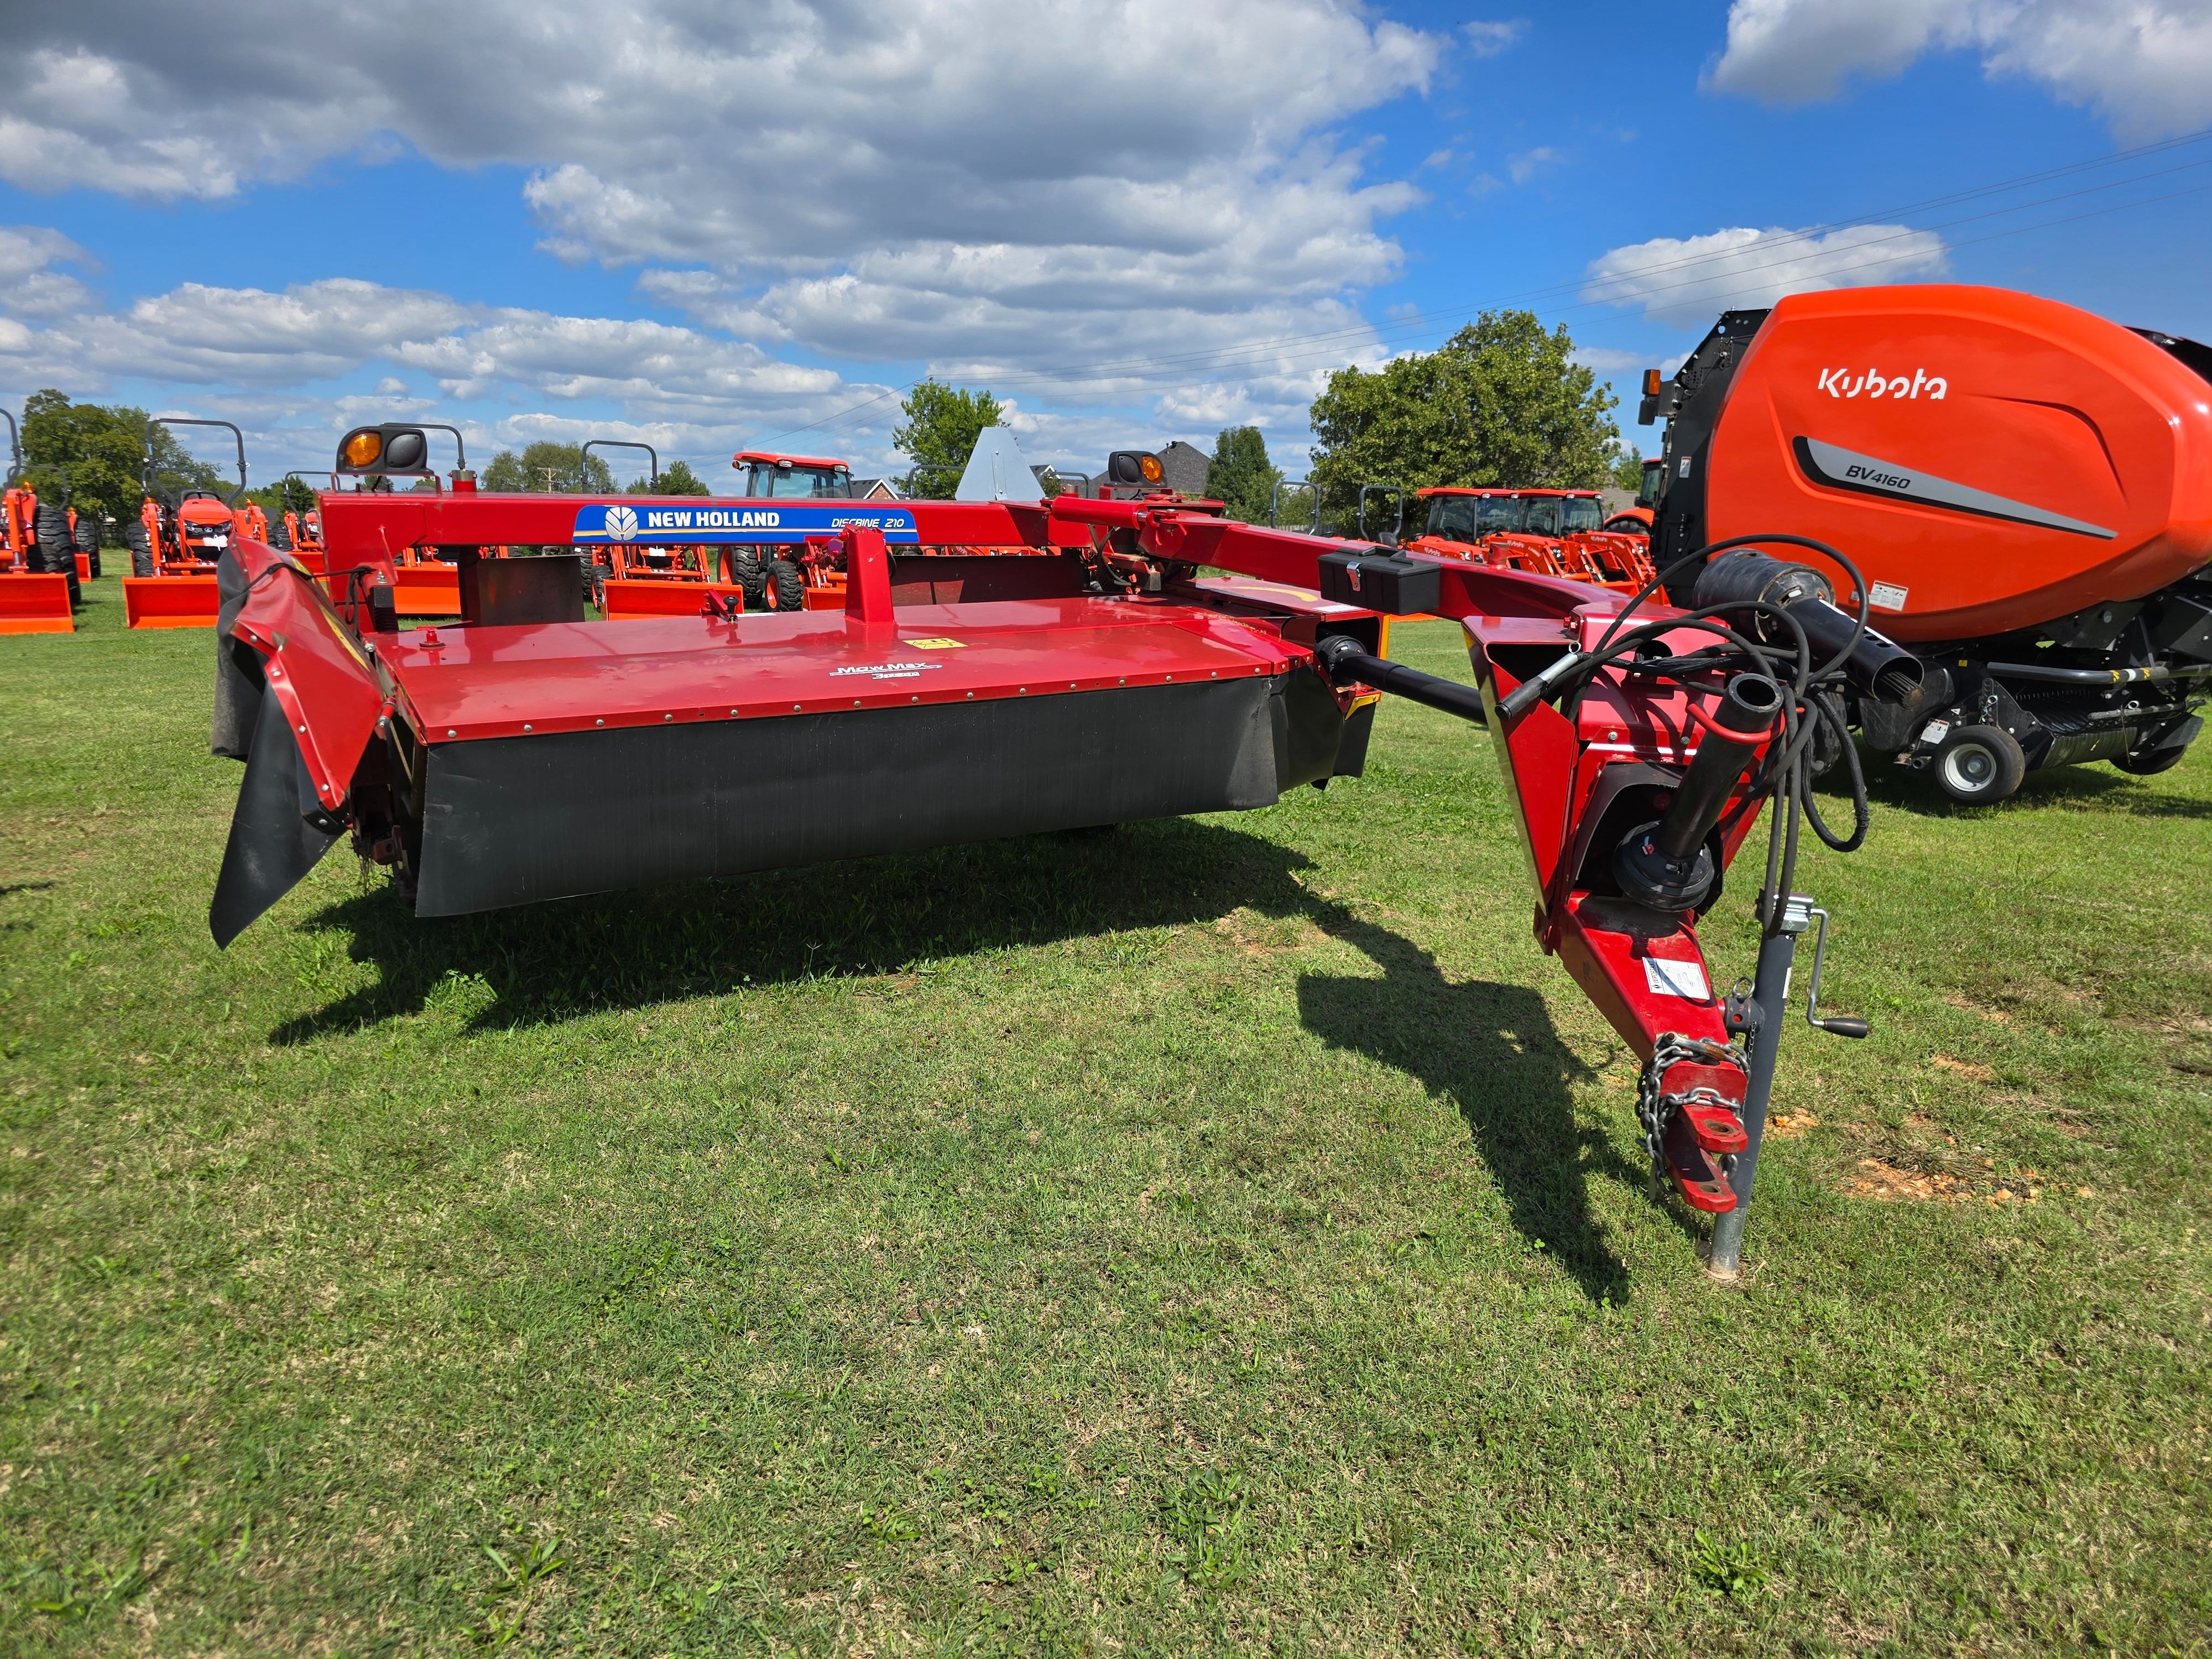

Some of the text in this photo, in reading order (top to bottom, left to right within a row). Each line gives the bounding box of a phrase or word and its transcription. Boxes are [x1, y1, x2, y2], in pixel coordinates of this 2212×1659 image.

[1817, 368, 1947, 399] Kubota
[1845, 465, 1911, 489] BV4160
[648, 512, 780, 527] NEW HOLLAND
[884, 518, 905, 528] 210
